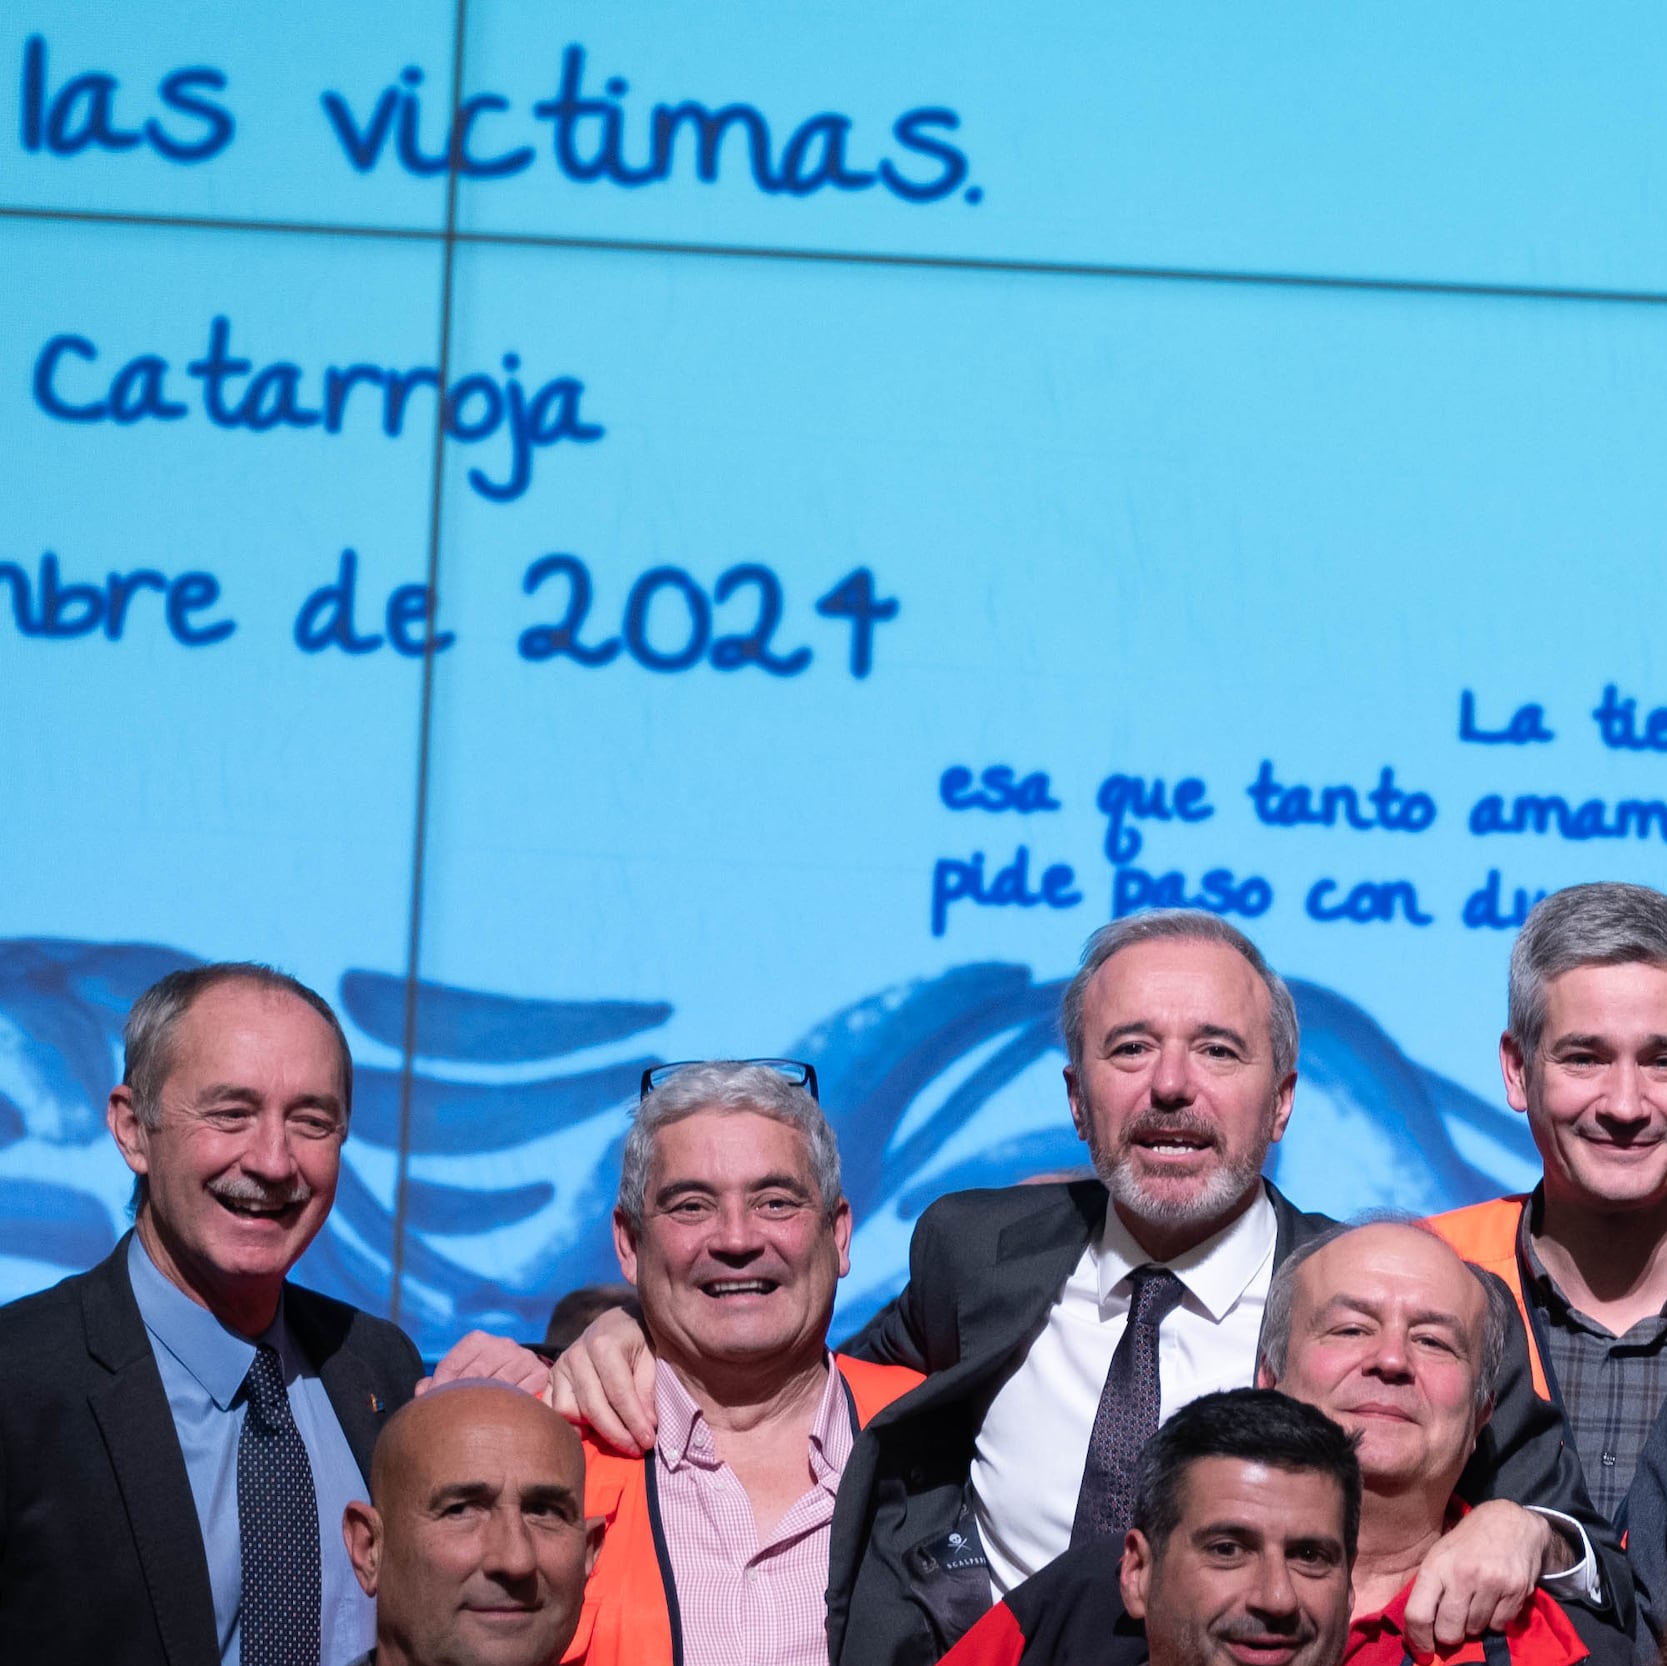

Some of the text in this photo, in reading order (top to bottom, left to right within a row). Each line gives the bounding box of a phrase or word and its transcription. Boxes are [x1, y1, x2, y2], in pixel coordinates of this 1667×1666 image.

[21, 34, 235, 161] las
[293, 547, 455, 656] de
[518, 553, 898, 680] 2024
[1458, 689, 1554, 743] La
[938, 762, 1060, 814] esa
[1096, 768, 1215, 862] que
[1247, 759, 1438, 834] tanto
[932, 847, 1084, 937] pide
[1304, 866, 1434, 930] con
